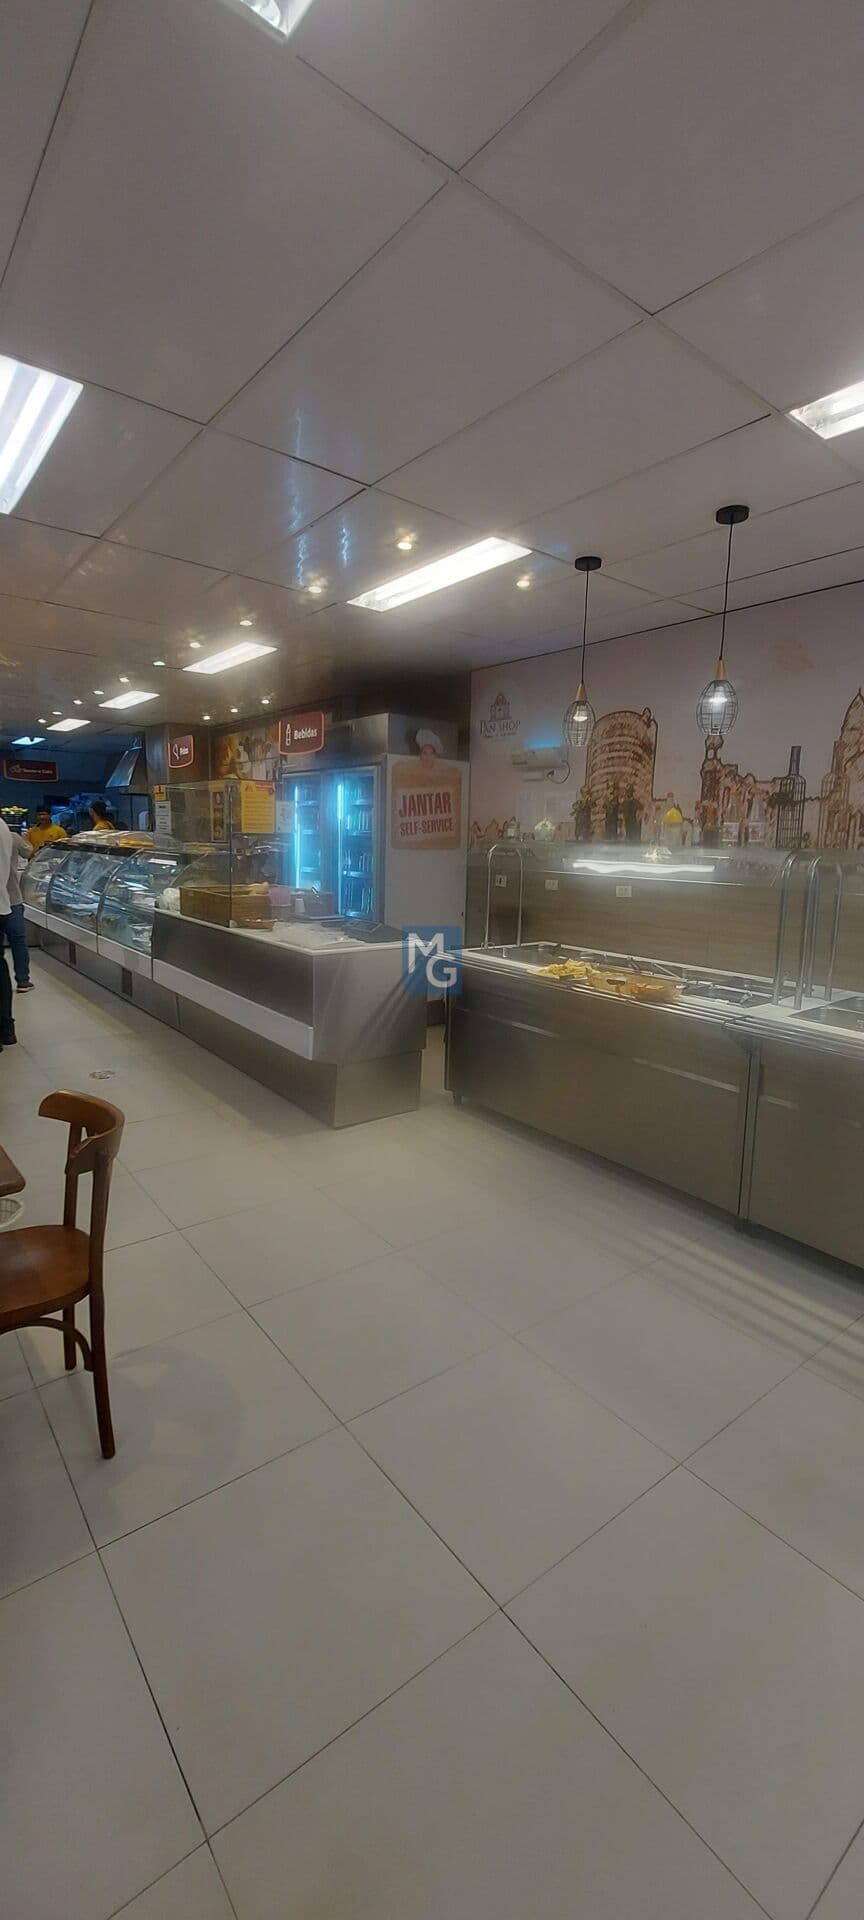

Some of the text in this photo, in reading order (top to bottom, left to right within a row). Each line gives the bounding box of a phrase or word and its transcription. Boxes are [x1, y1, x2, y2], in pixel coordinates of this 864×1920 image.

[294, 728, 318, 740] Bebidas
[399, 792, 452, 817] JANTAR
[400, 817, 454, 836] SELF-SERVICE
